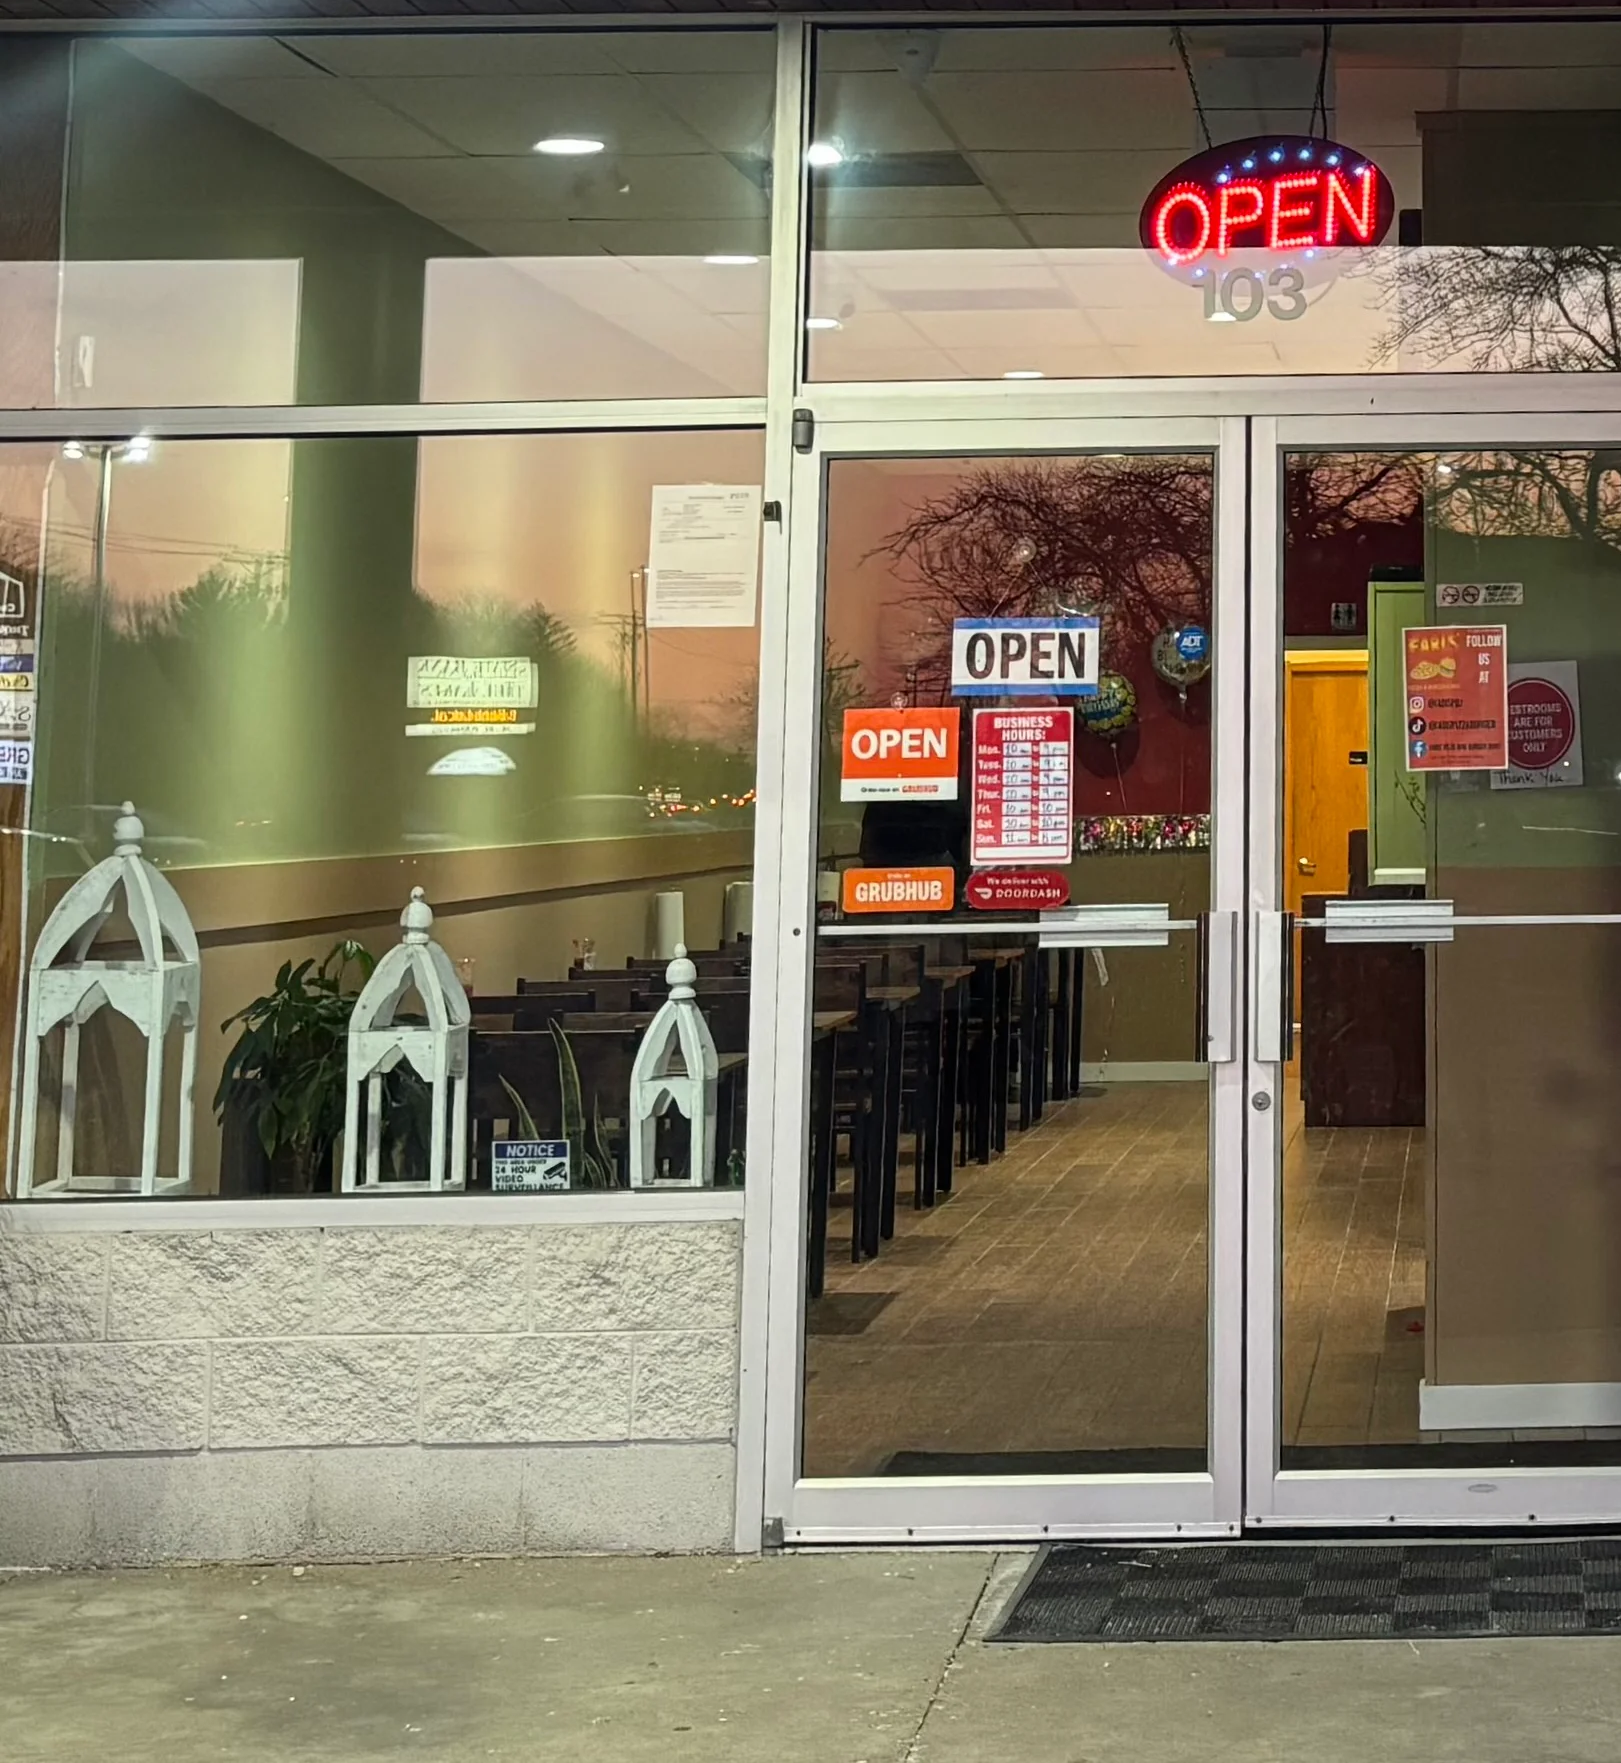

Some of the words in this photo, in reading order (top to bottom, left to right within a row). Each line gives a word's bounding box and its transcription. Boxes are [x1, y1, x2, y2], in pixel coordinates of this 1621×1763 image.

[1155, 165, 1379, 264] OPEN
[1193, 267, 1308, 321] 103
[1180, 635, 1203, 648] ADT
[1466, 634, 1502, 648] FOLLOW
[965, 632, 1086, 680] OPEN
[1478, 652, 1490, 666] US
[1478, 670, 1490, 684] AT
[1508, 703, 1562, 715] ESTROOMS
[993, 715, 1054, 729] BUSINESS
[1513, 716, 1533, 727] ARE
[1533, 715, 1554, 727] FOR
[1001, 728, 1047, 742] HOURS:
[850, 727, 948, 761] OPEN
[1522, 742, 1548, 753] ONLY
[855, 880, 943, 903] GRUBHUB
[995, 888, 1061, 899] DOORDASH
[506, 1144, 555, 1157] NOTICE
[495, 1166, 506, 1174] 24
[511, 1165, 537, 1174] HOUR
[495, 1174, 524, 1183] VIDEO
